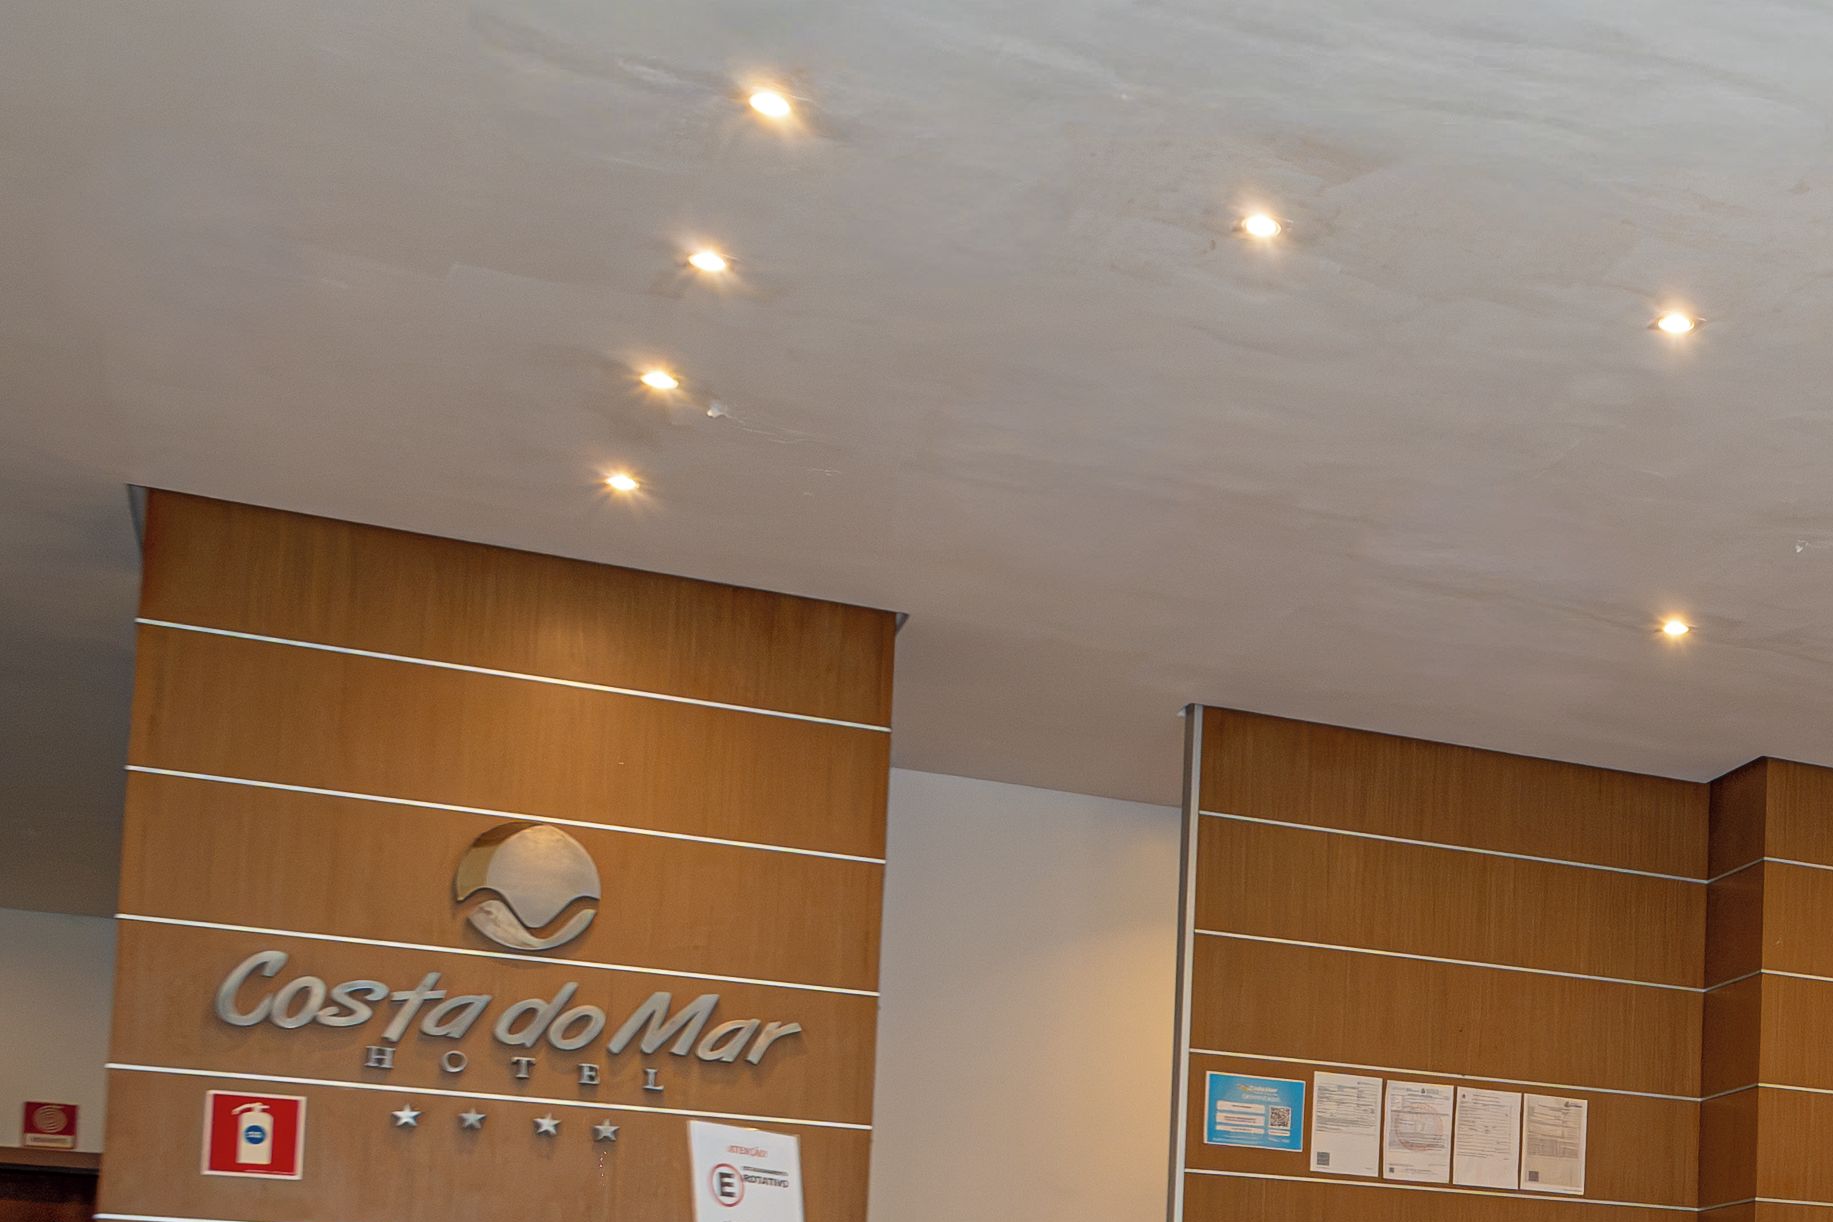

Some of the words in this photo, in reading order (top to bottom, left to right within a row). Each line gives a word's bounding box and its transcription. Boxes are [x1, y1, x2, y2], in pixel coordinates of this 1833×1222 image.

[215, 950, 493, 1043] Costa
[493, 982, 606, 1051] do
[607, 991, 802, 1066] Mar
[719, 1172, 736, 1198] E
